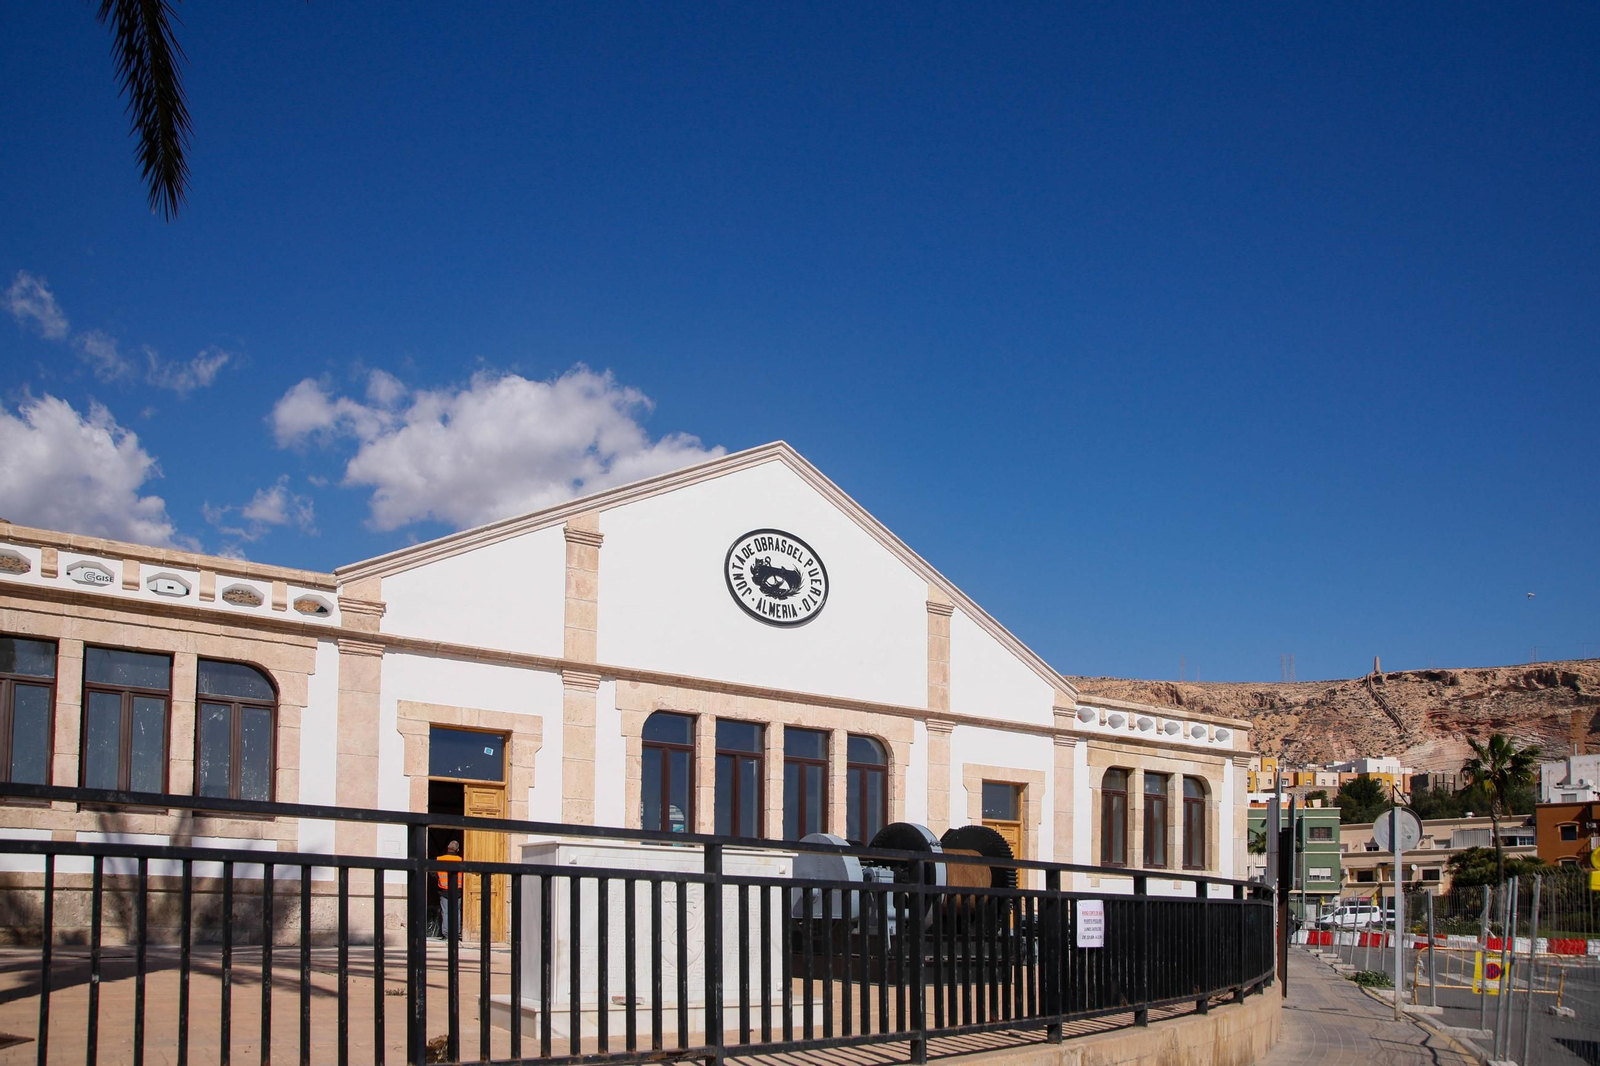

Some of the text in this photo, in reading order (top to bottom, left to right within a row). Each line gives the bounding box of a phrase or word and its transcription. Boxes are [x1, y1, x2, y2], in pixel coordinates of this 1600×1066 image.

[732, 554, 753, 597] JUNTA
[753, 536, 787, 553] OBRAS
[802, 558, 822, 612] PUERTO
[755, 597, 798, 619] ALMERIA
